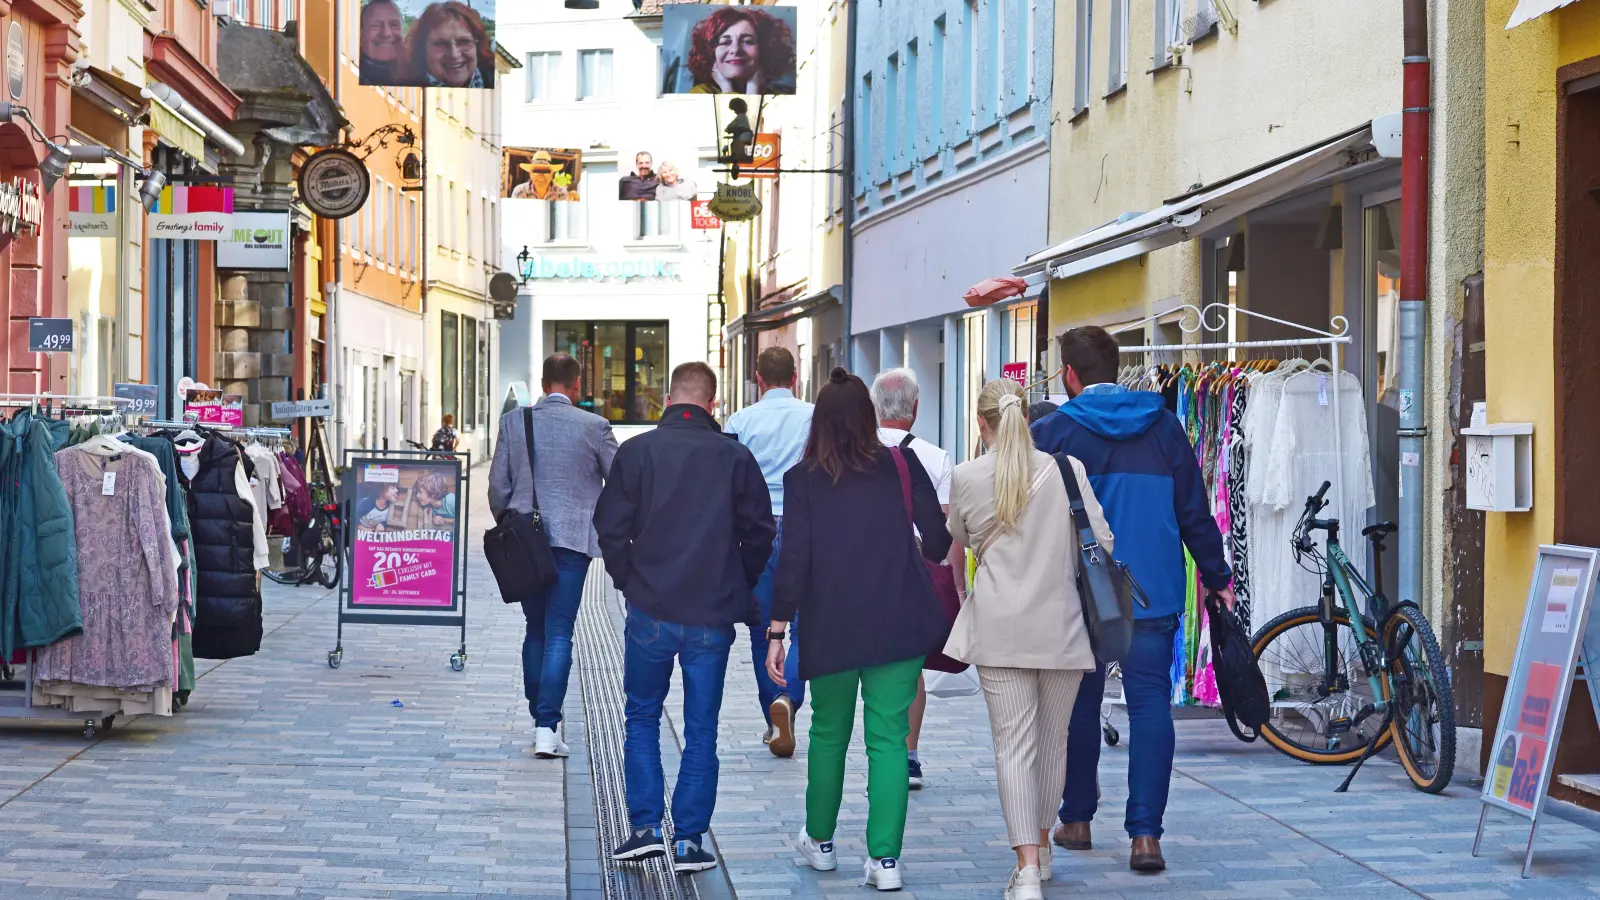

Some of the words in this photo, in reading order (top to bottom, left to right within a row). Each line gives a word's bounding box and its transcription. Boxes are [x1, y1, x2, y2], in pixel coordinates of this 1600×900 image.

[156, 221, 193, 234] Ernsting's
[194, 221, 224, 233] family
[43, 334, 71, 351] 49,99
[1003, 369, 1026, 380] SALE
[127, 398, 155, 412] 49,99
[357, 529, 451, 543] WELTKINDERTAG
[424, 561, 433, 569] MIT
[399, 573, 419, 583] FAMILY
[420, 568, 437, 578] CARD
